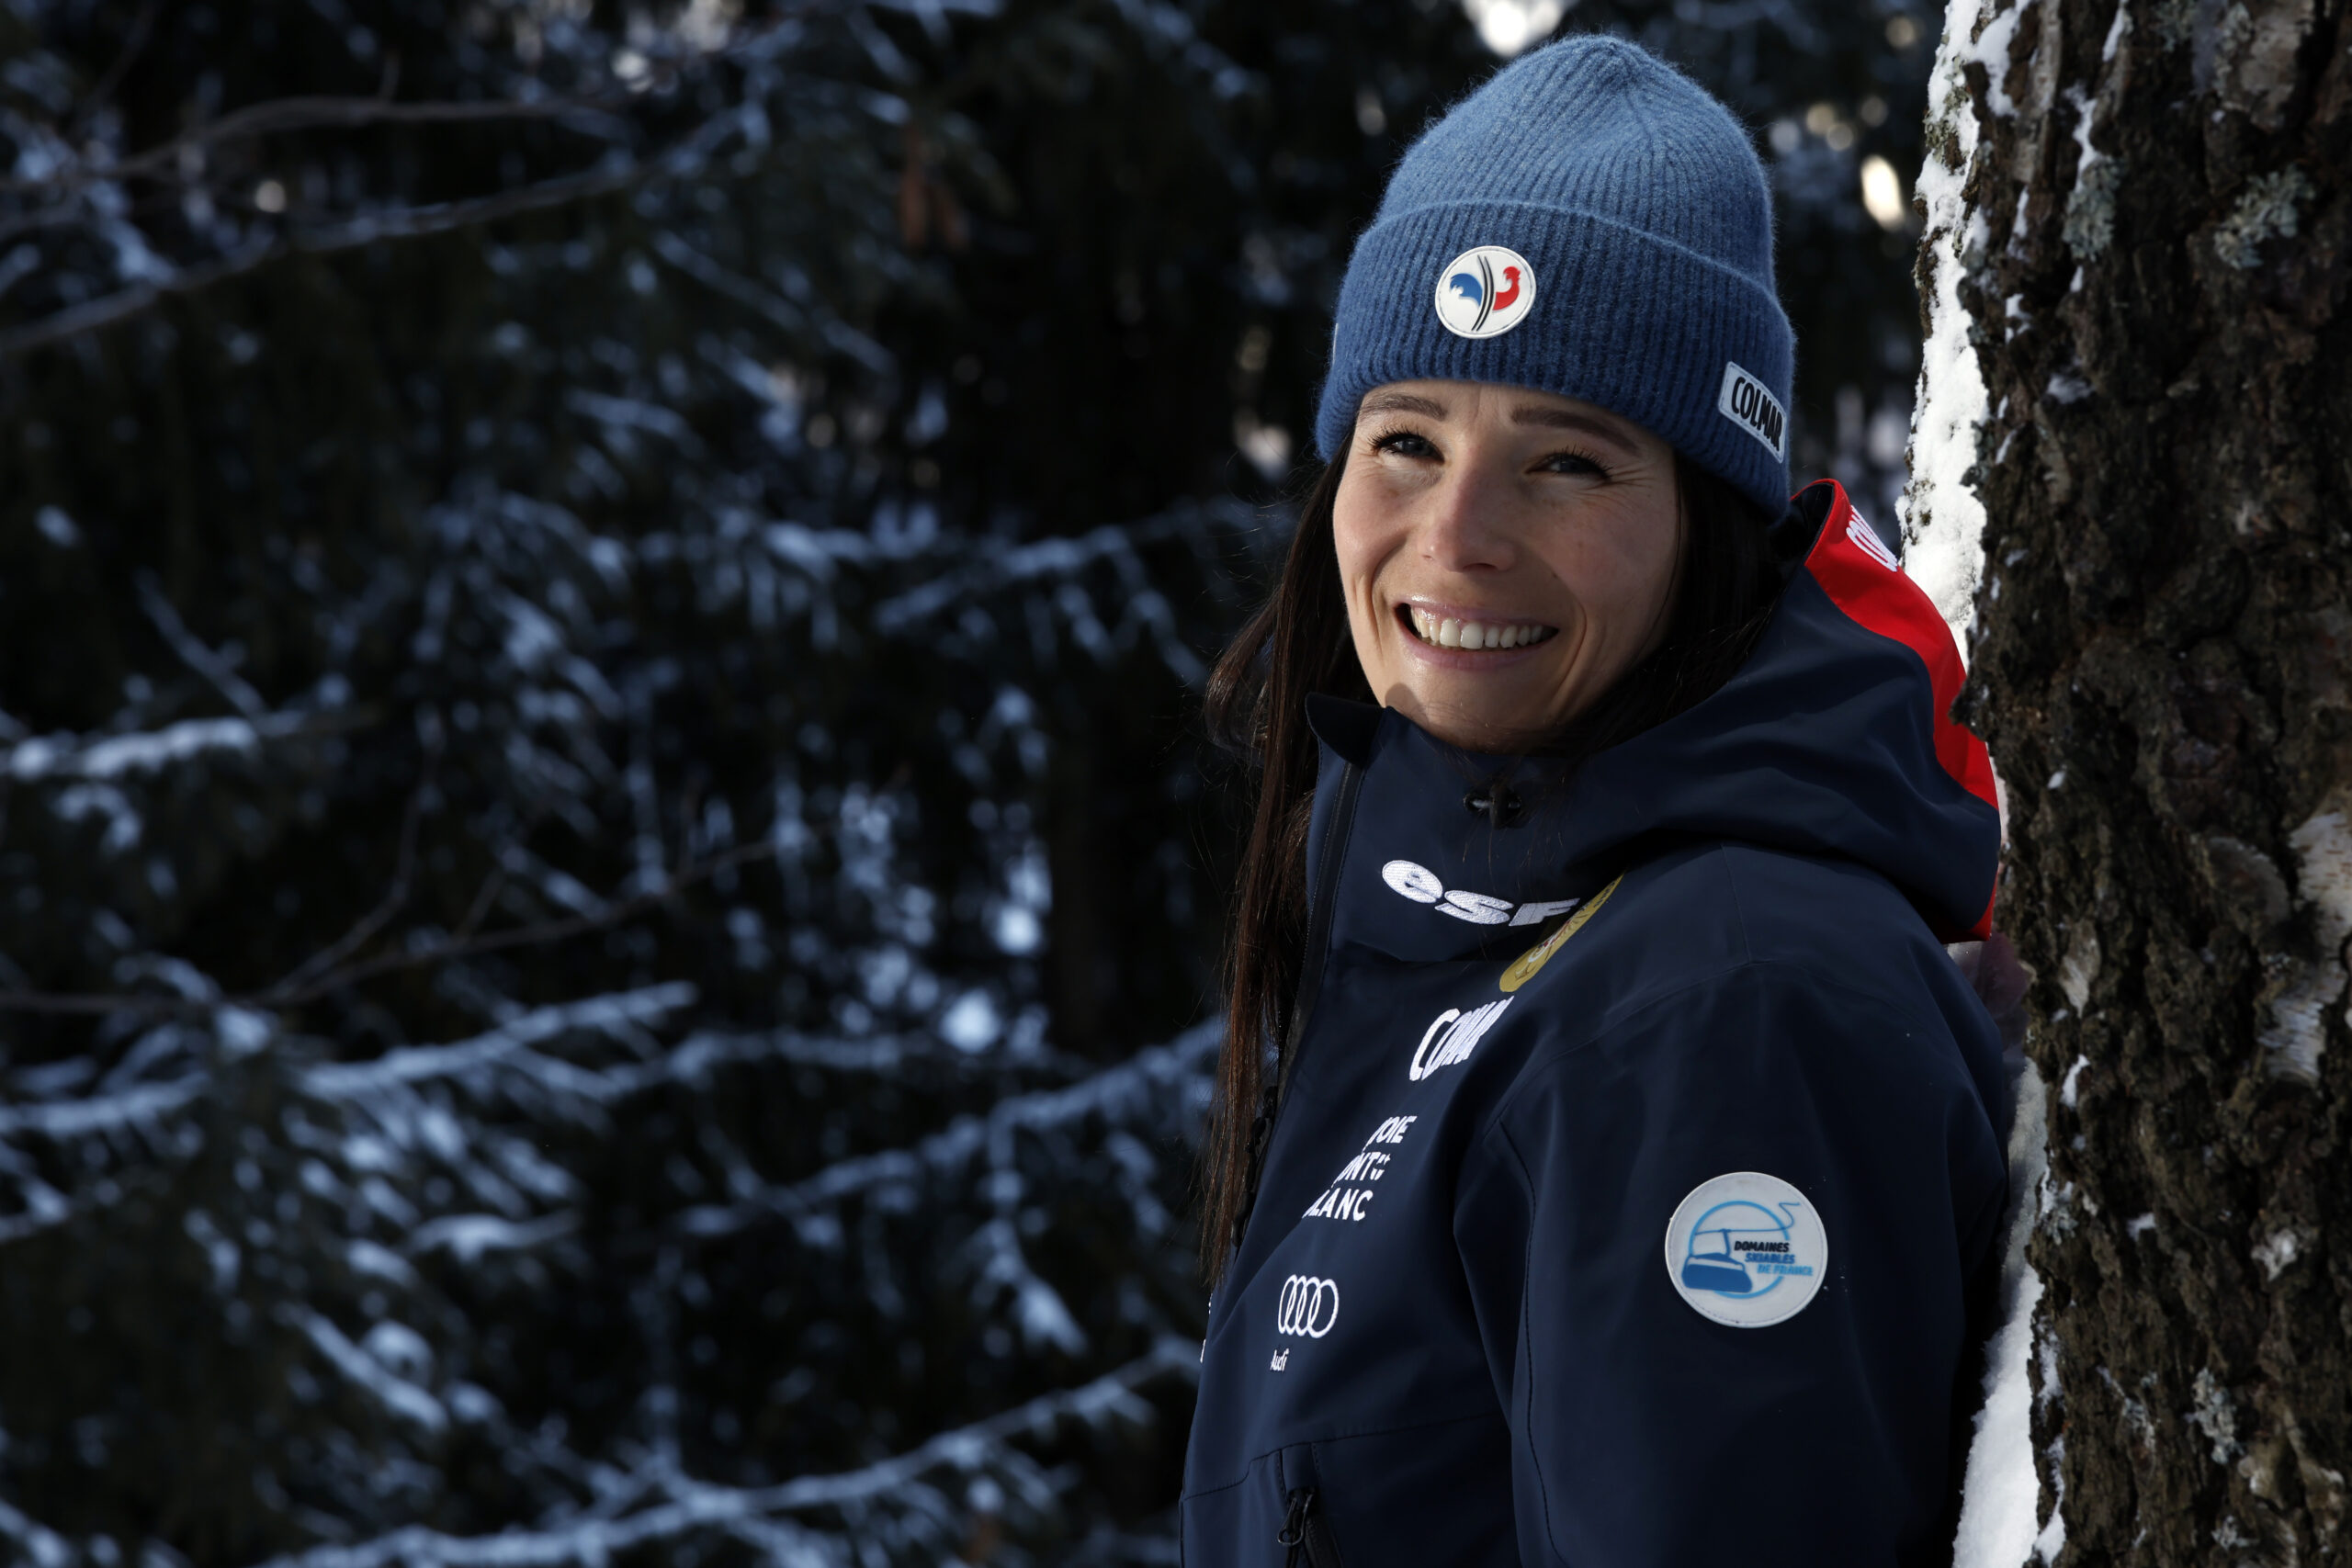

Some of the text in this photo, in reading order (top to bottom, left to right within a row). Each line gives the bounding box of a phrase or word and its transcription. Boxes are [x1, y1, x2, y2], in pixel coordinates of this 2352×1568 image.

[1732, 377, 1782, 452] COLMAR
[1734, 1240, 1790, 1253] DOMAINES
[1745, 1252, 1795, 1264] SKIABLES
[1757, 1263, 1771, 1274] DE
